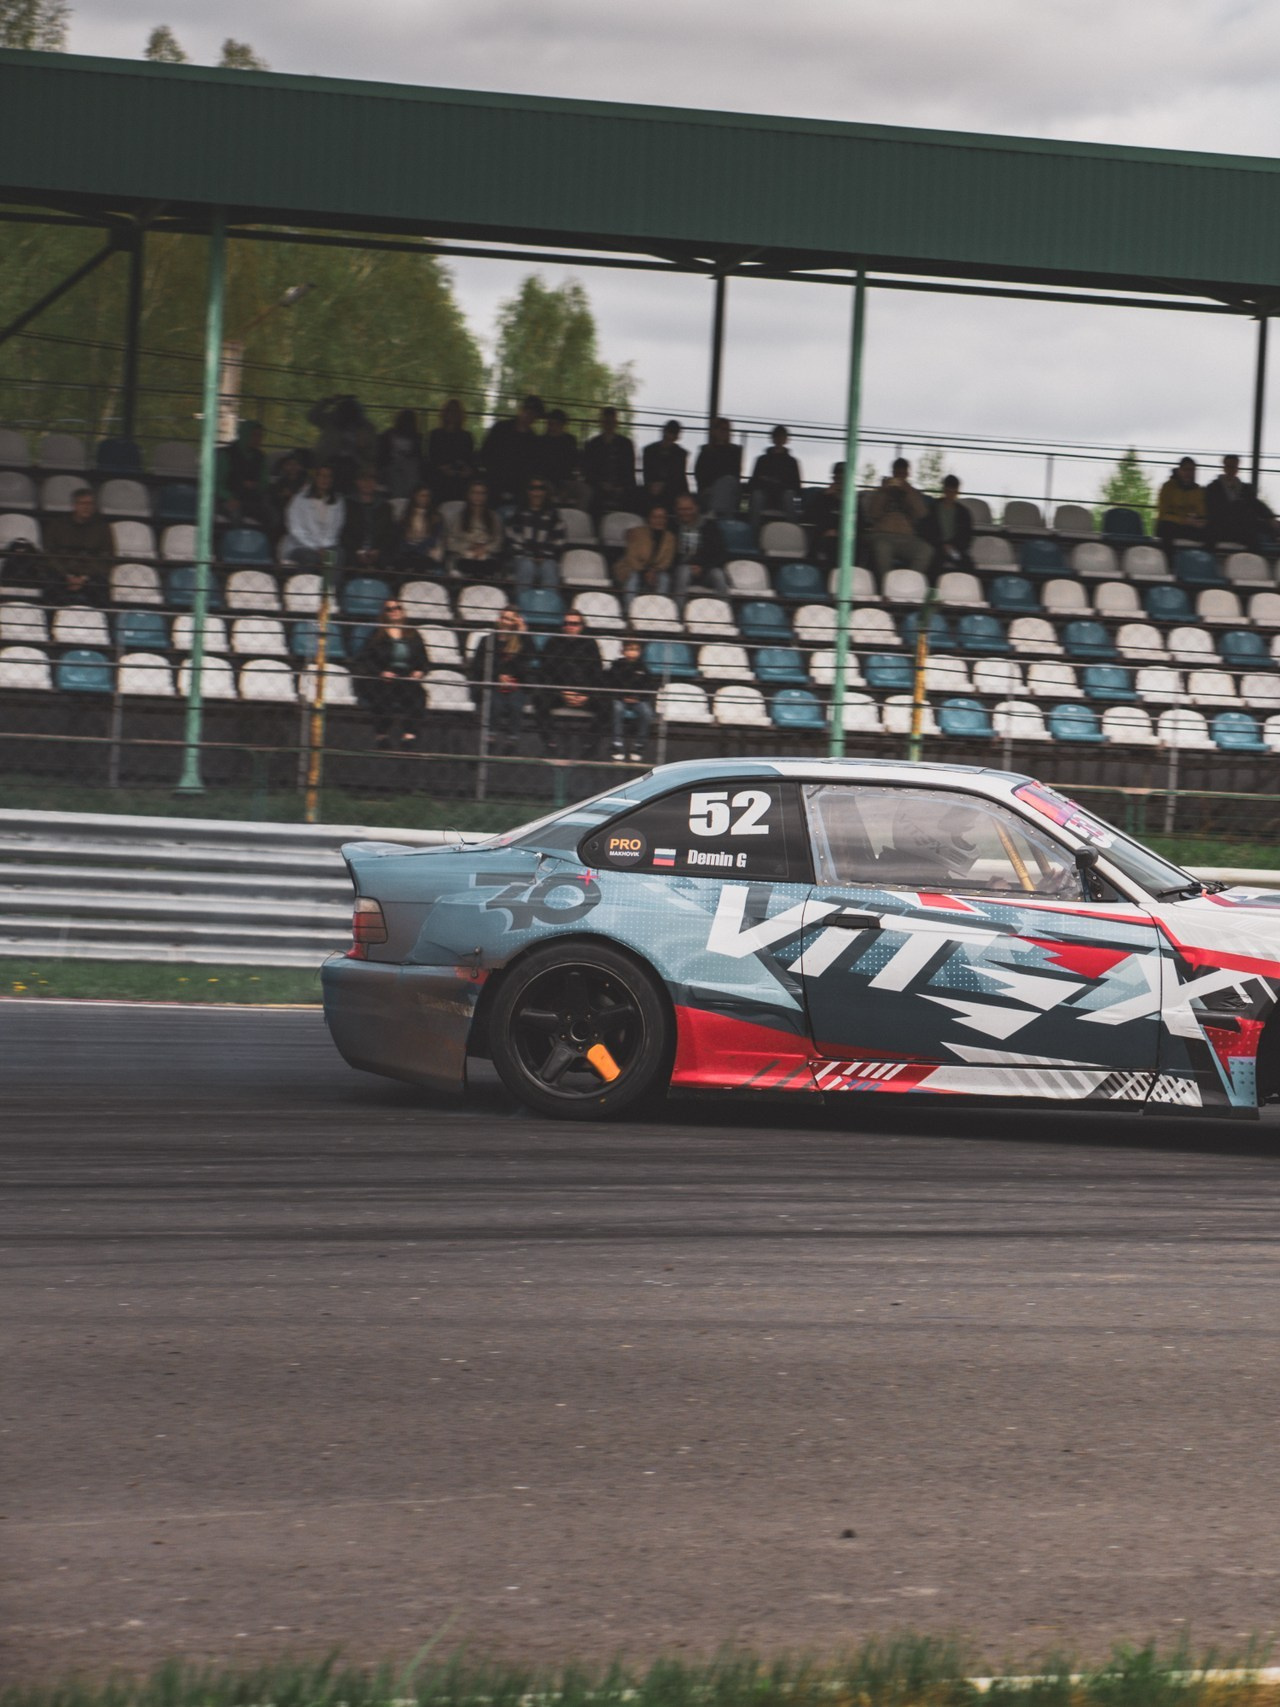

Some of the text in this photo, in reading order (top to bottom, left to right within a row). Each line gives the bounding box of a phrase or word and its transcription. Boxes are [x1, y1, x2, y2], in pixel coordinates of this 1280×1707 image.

[688, 790, 772, 837] 52
[609, 838, 642, 850] PRO
[687, 849, 748, 868] Demin G
